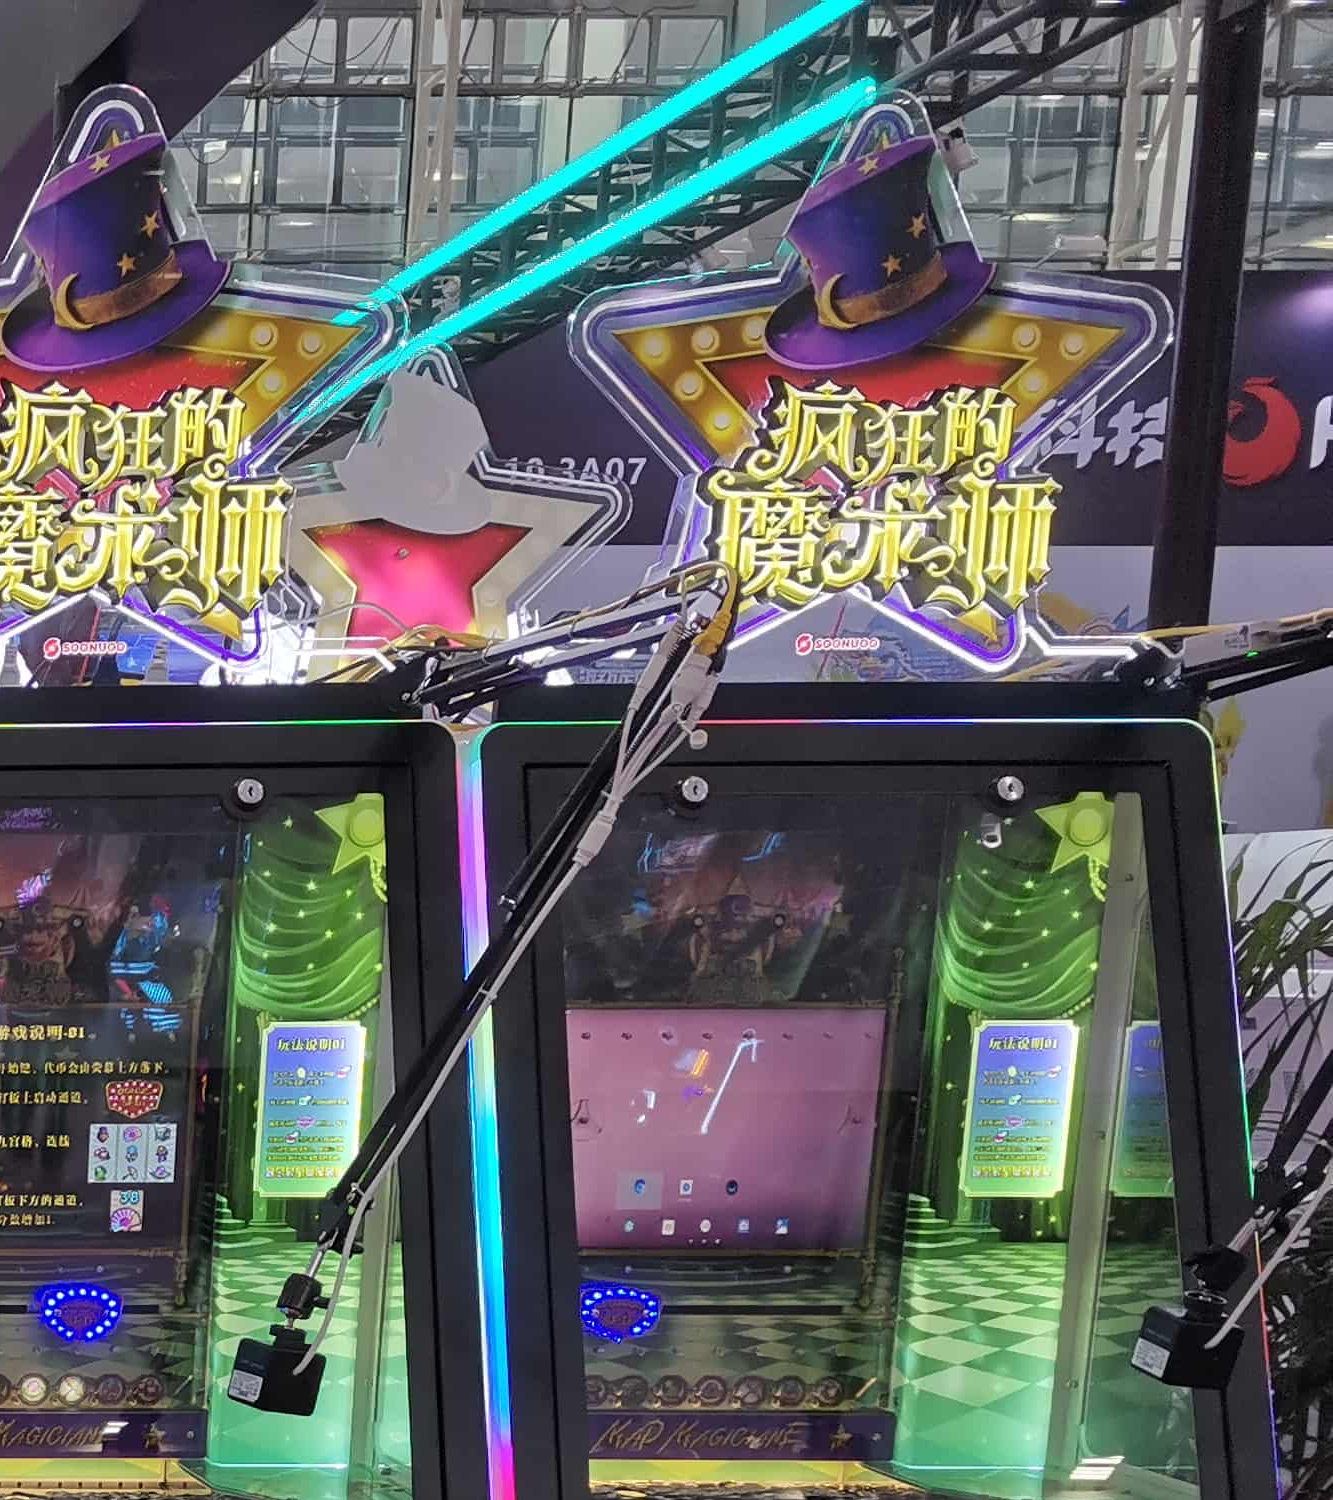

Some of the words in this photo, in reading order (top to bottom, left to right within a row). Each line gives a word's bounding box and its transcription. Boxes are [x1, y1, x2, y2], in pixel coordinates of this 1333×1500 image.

[745, 379, 1017, 487] 疯狂的
[697, 467, 1061, 610] 魔术师
